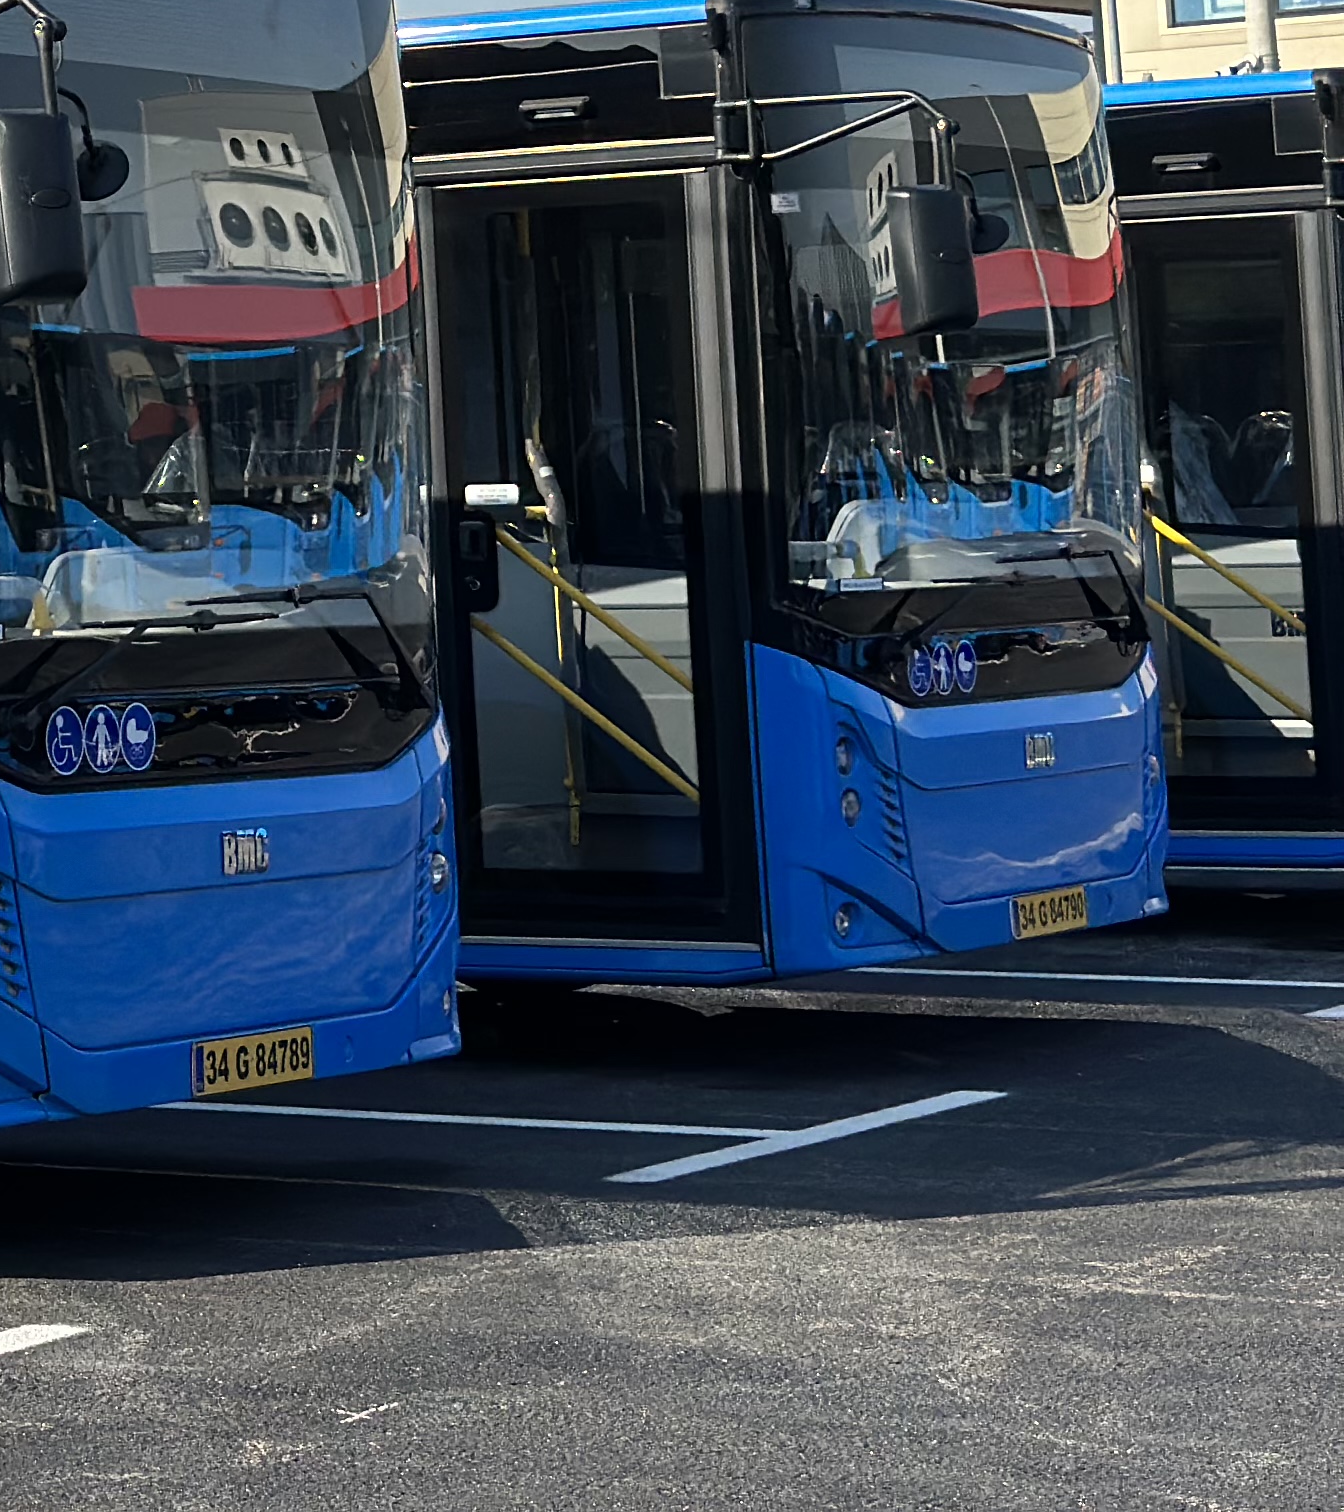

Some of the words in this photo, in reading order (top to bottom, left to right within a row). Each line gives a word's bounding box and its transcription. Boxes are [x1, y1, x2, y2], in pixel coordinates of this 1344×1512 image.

[221, 828, 269, 875] BMC
[1020, 902, 1036, 930] 34
[1039, 900, 1048, 926] G
[1050, 891, 1084, 923] 84790
[206, 1048, 230, 1085] 34
[236, 1045, 249, 1080] G
[255, 1036, 310, 1077] 84789
